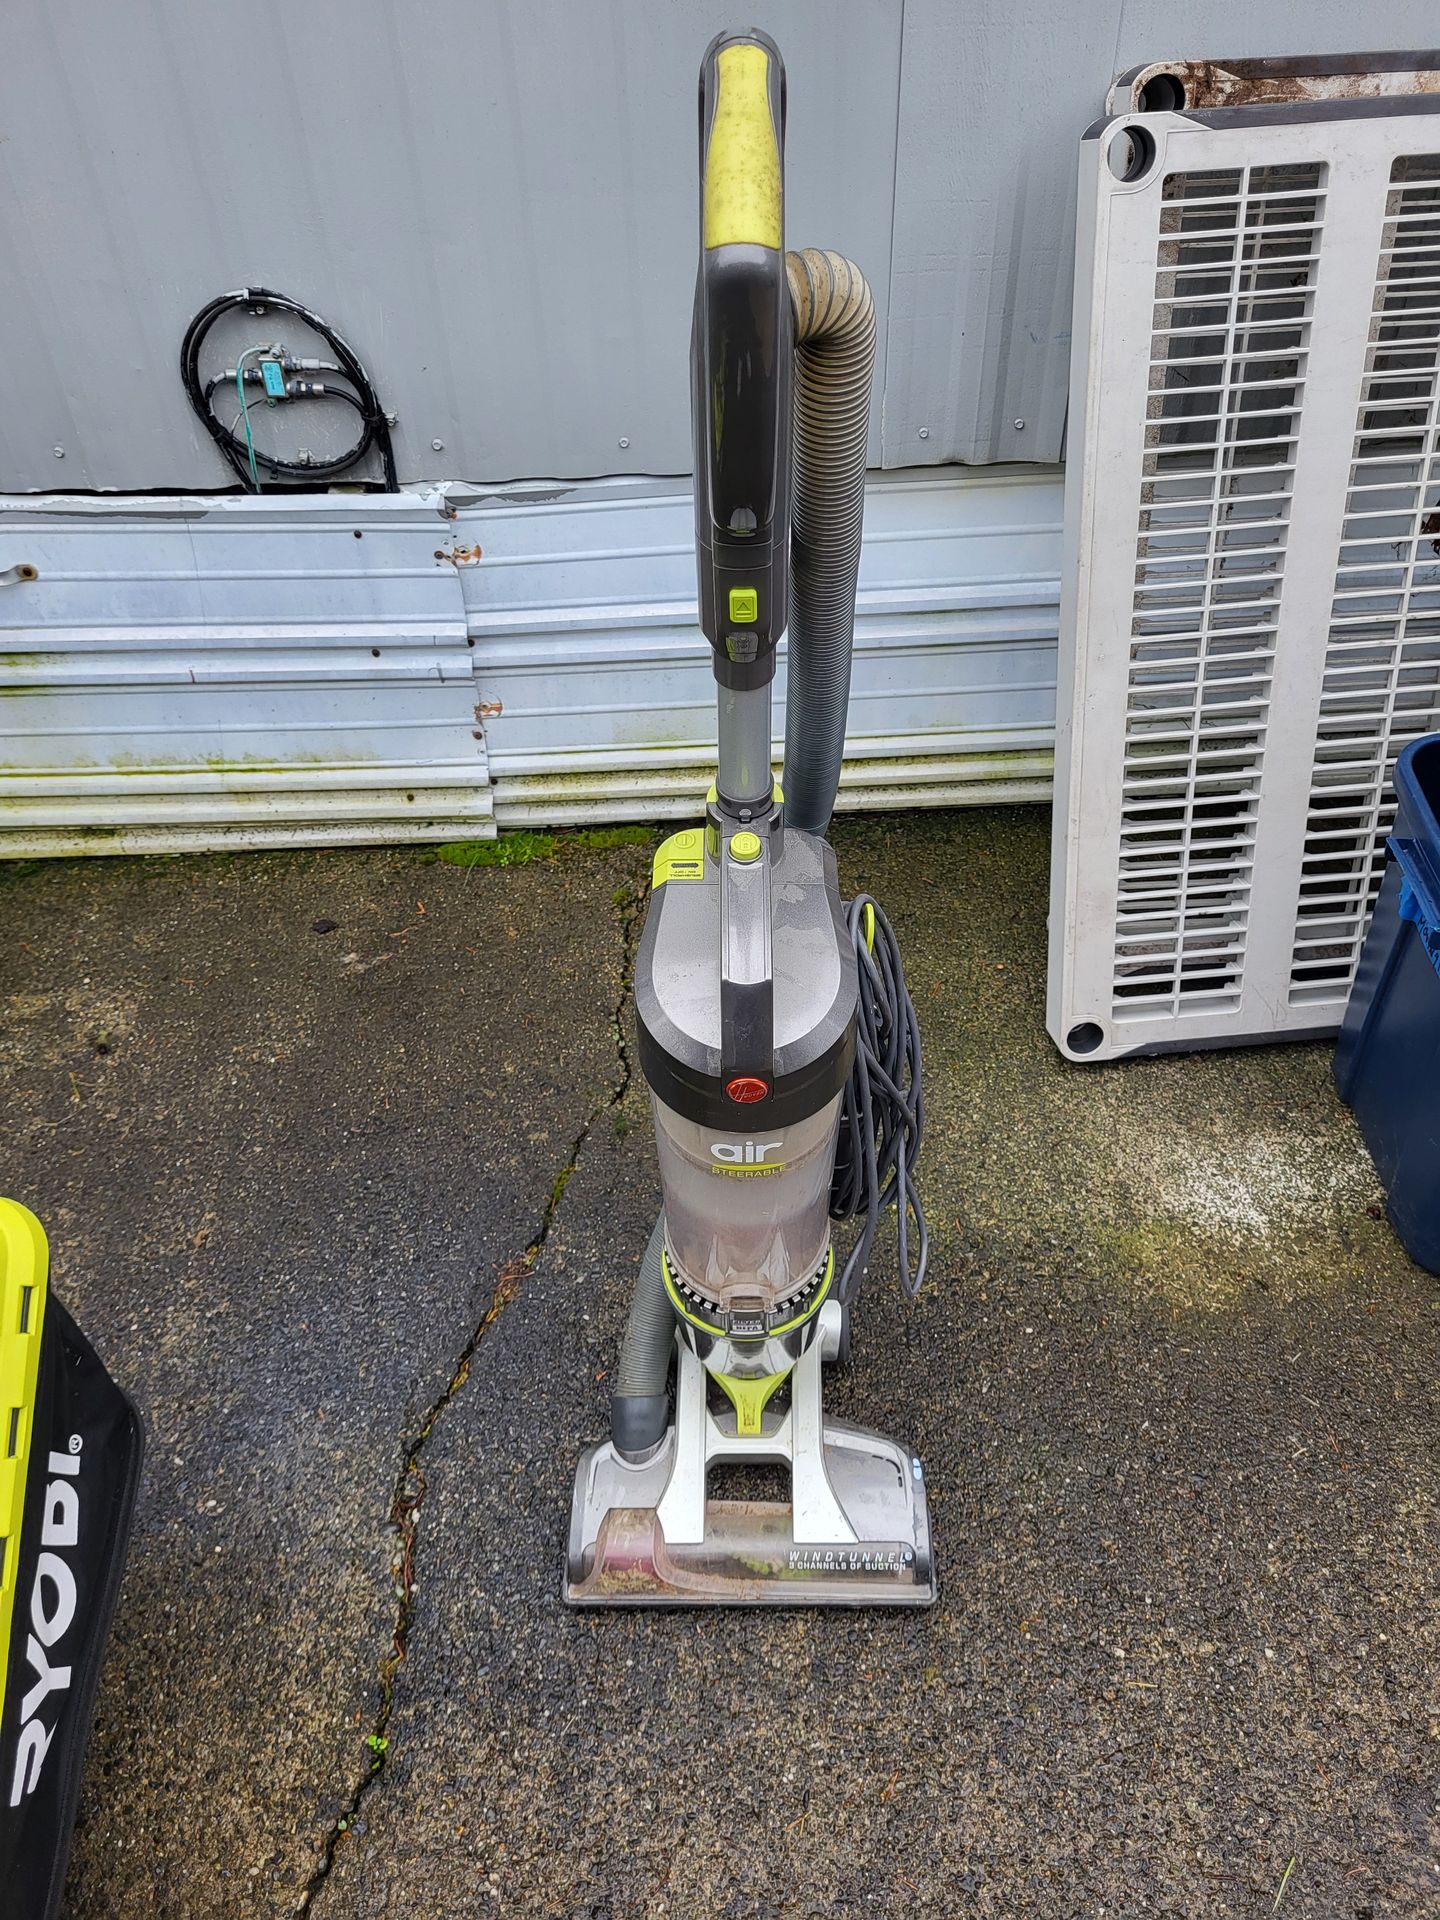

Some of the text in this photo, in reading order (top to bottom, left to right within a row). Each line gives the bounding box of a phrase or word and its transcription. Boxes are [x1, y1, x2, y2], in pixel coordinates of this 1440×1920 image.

[710, 1141, 783, 1163] air
[712, 1165, 786, 1178] STEERABLE
[789, 1551, 906, 1563] WINDTUNNEL
[797, 1561, 847, 1570] CHANNELS
[850, 1561, 862, 1570] OF
[865, 1561, 906, 1571] SUCTION
